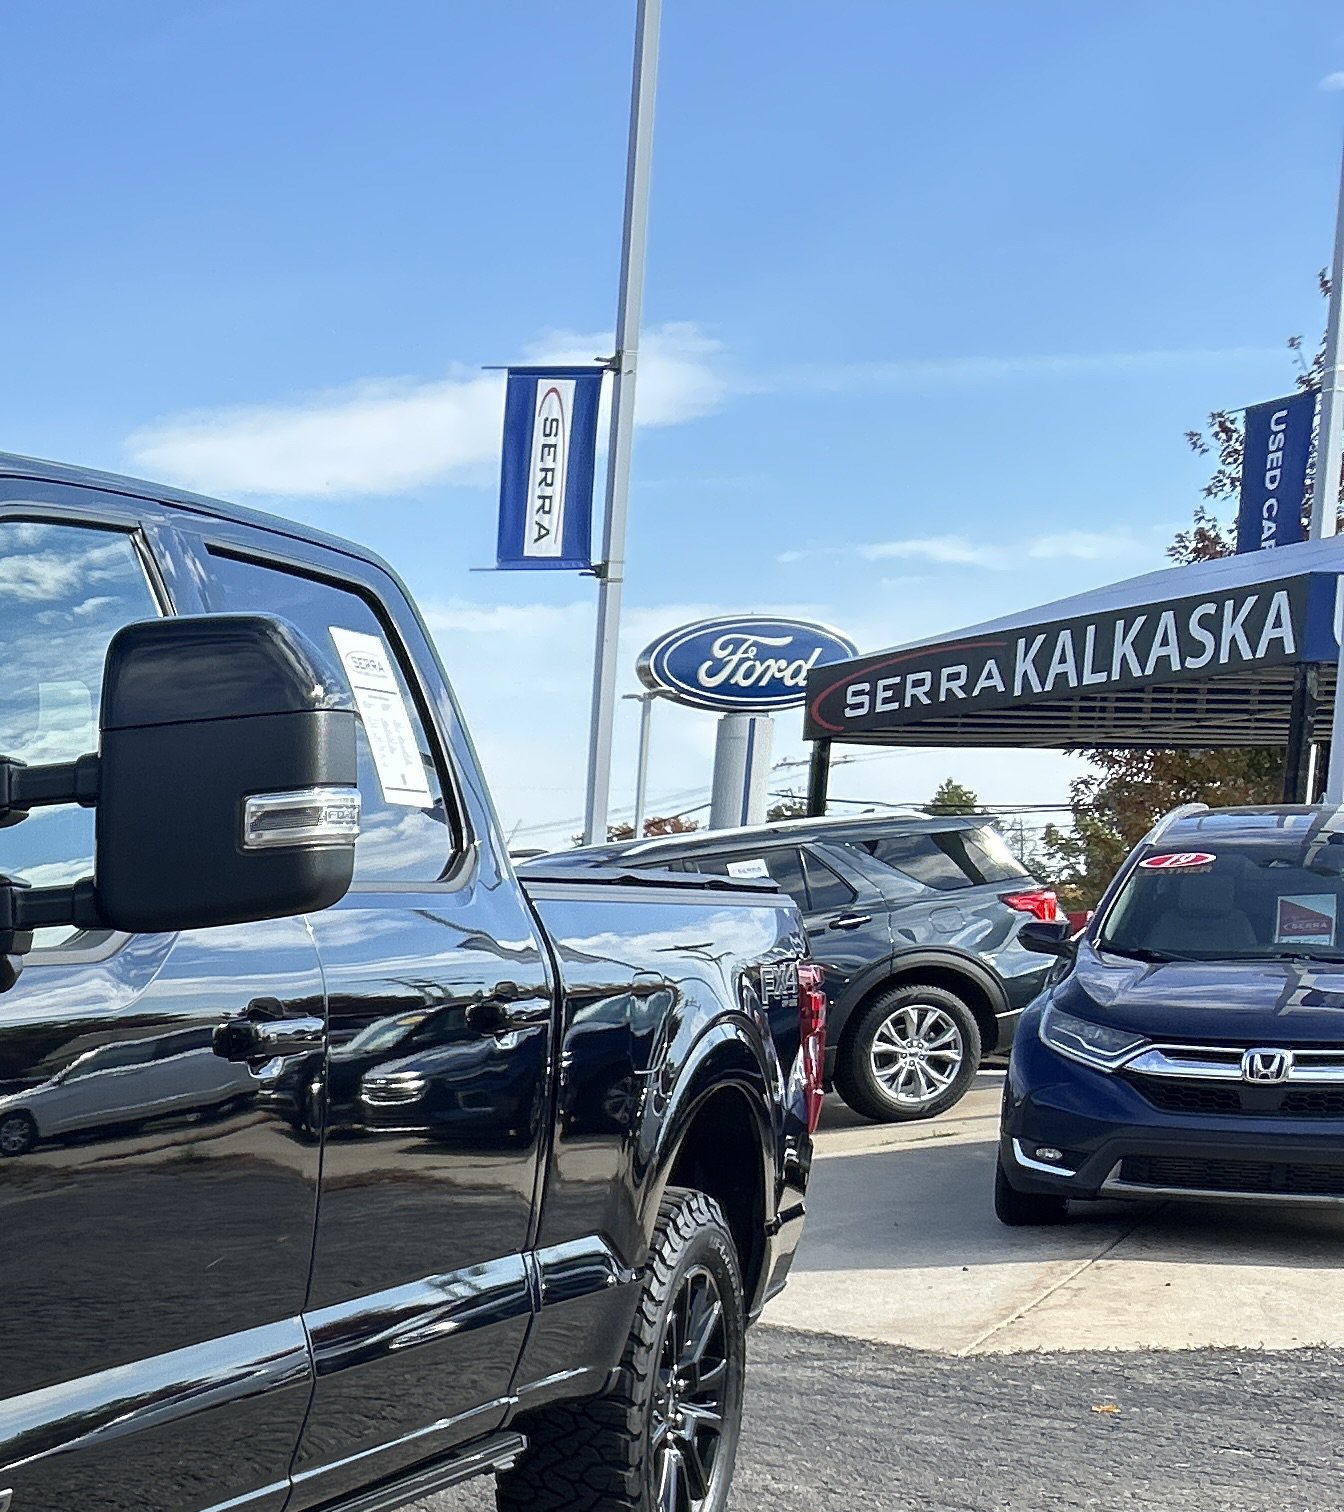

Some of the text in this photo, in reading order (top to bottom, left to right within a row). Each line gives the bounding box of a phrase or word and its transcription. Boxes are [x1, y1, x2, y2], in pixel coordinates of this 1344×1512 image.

[533, 417, 560, 545] SERRA
[1265, 409, 1288, 491] USED
[696, 633, 823, 688] Ford
[844, 659, 1007, 719] SERRA
[1012, 590, 1296, 698] KALKASKA
[760, 962, 798, 1009] FX4
